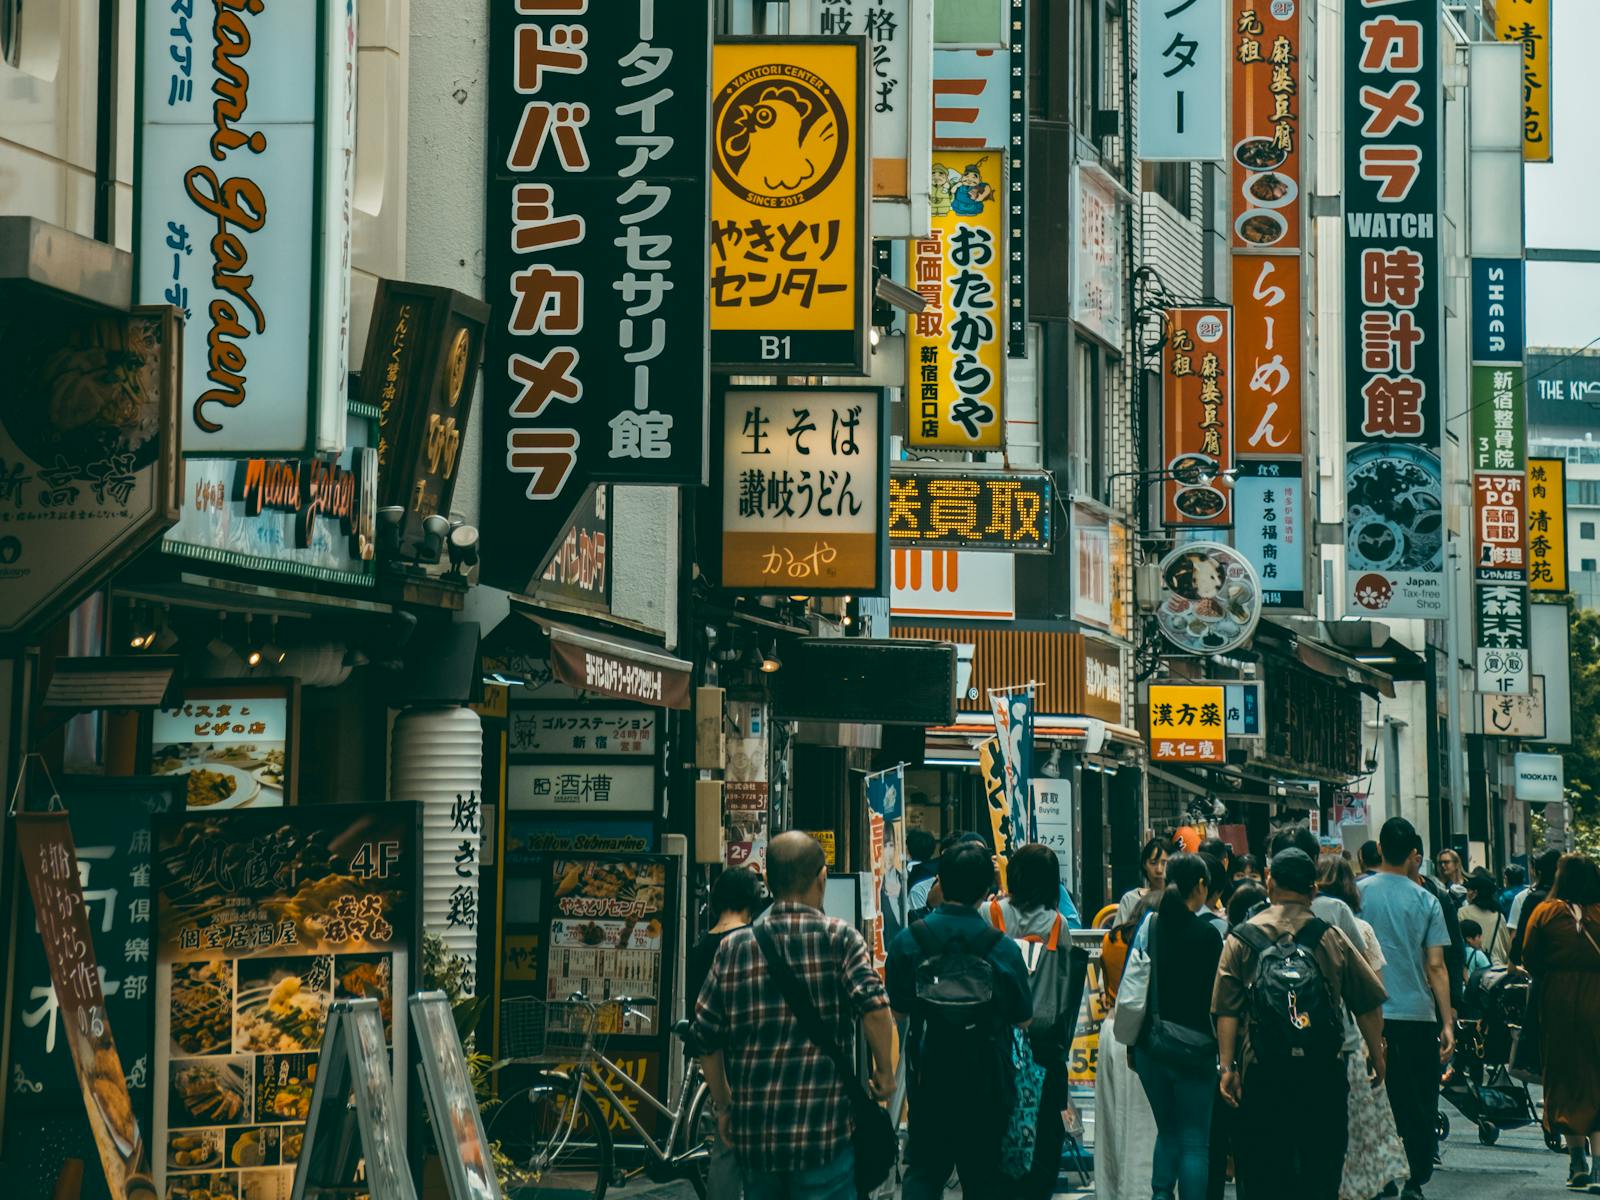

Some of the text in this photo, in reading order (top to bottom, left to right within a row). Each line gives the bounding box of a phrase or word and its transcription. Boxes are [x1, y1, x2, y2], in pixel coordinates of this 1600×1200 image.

[1237, 9, 1264, 64] 元祖
[731, 66, 824, 90] YAKITORI CENTER
[746, 192, 806, 208] SINCE 2012
[1347, 212, 1434, 238] WATCH
[711, 218, 841, 262] やきとり
[711, 265, 848, 309] センター
[950, 225, 995, 439] おたからや
[1360, 245, 1425, 439] 時計館
[760, 336, 791, 360] B1
[1170, 328, 1194, 377] 元祖
[1247, 260, 1292, 448] らーめん
[920, 345, 939, 439] 新宿西口店
[1538, 380, 1564, 400] THE
[741, 405, 862, 456] 生そば
[1493, 370, 1514, 469] 新宿整骨院
[738, 468, 863, 519] 讃岐うどん
[1478, 476, 1520, 491] スマホ
[1530, 465, 1547, 499] 焼肉
[1486, 491, 1514, 505] PC
[1486, 509, 1515, 524] 高価
[1262, 489, 1278, 579] まる福商店
[1486, 524, 1516, 540] 買取
[1493, 547, 1522, 564] 修理
[1528, 509, 1554, 583] 清香苑
[761, 541, 837, 578] かのや
[1402, 589, 1440, 599] Tax-free
[1405, 576, 1440, 588] Japan.
[1416, 599, 1441, 611] Shop
[1496, 678, 1515, 692] 1F
[541, 718, 654, 731] ゴルフステーション
[1152, 702, 1222, 727] 漢方薬
[194, 721, 266, 737] ピザの店
[554, 774, 613, 802] 酒槽
[1520, 772, 1558, 782] MOOKATA
[1040, 792, 1060, 804] 買取
[731, 845, 748, 859] 2F
[1039, 834, 1065, 846] カメラ
[350, 840, 400, 880] 4F
[559, 897, 658, 918] やきとりセンター
[178, 920, 299, 951] 個室居酒屋
